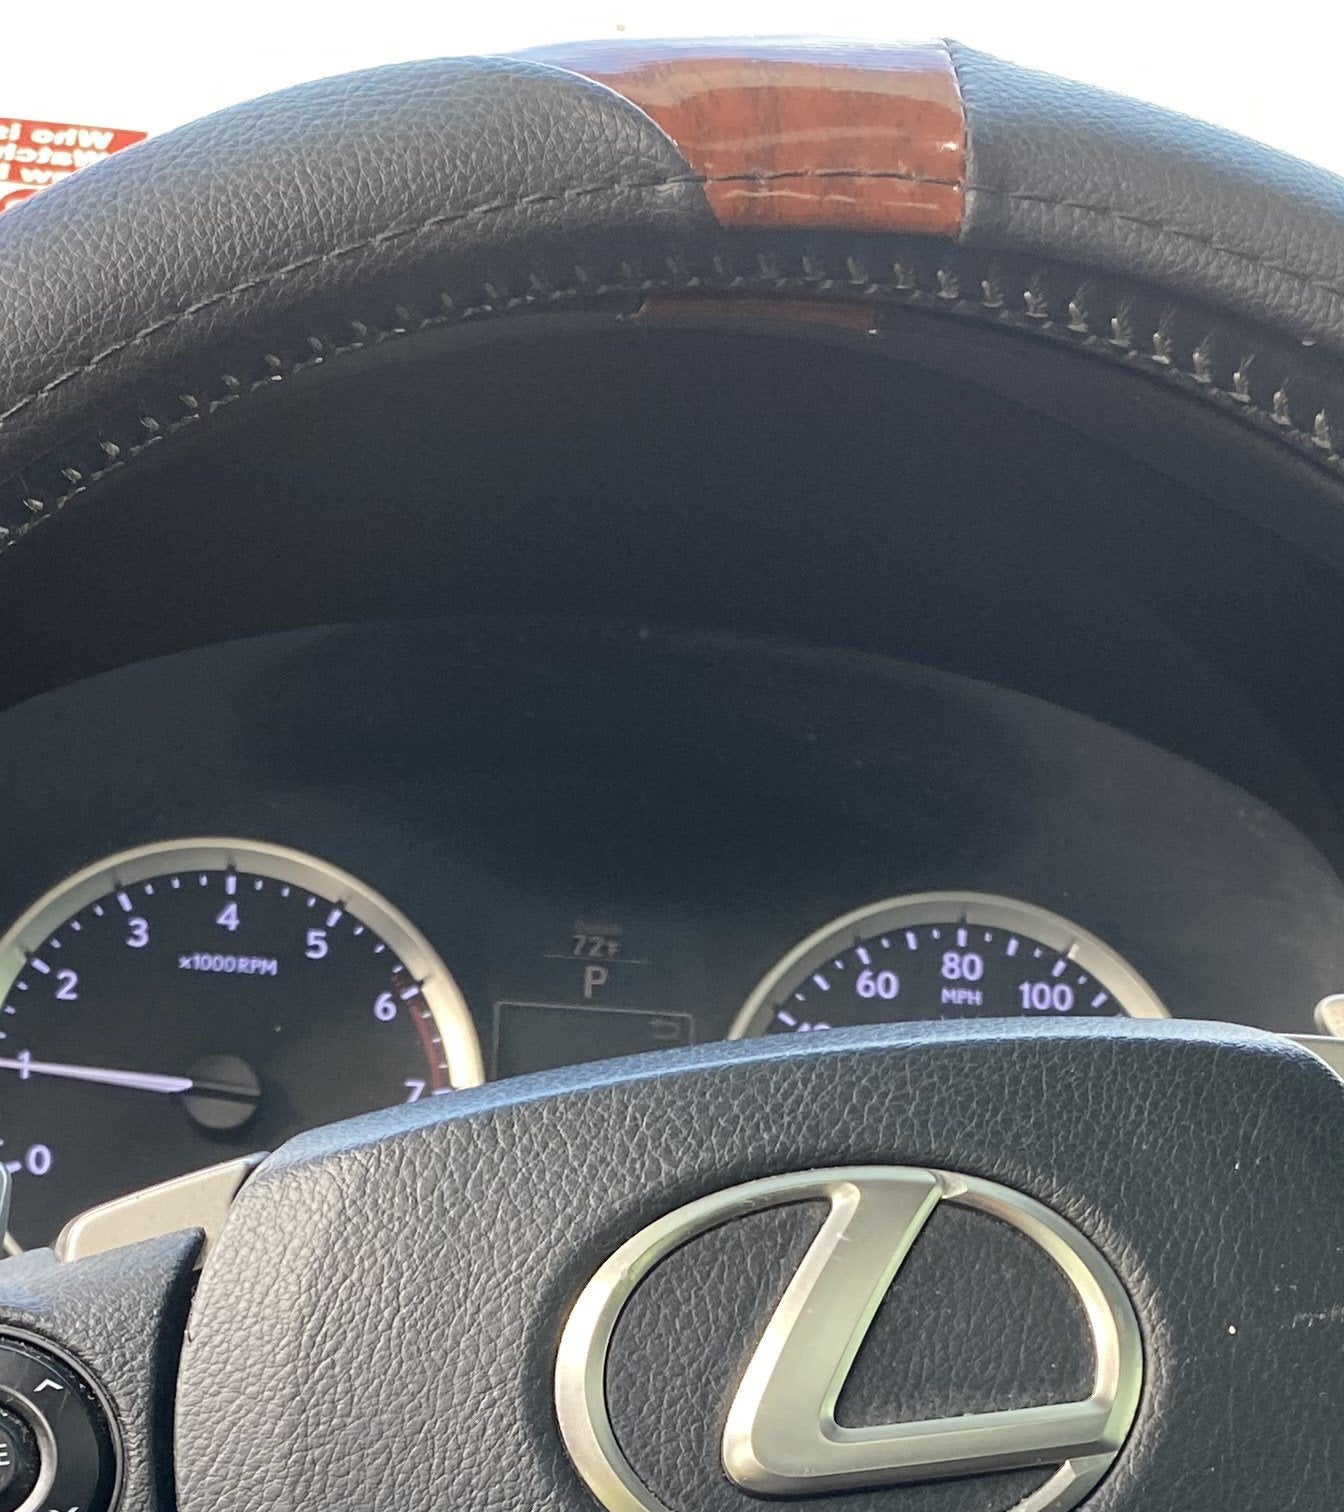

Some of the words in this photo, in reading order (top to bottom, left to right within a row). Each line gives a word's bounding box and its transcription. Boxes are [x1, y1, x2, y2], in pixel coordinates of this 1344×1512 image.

[216, 902, 240, 931] 4
[126, 917, 150, 949] 3
[305, 929, 328, 960] 5
[941, 951, 984, 982] 80
[55, 969, 79, 1001] 2
[584, 965, 609, 999] P
[856, 971, 899, 1000] 60
[1019, 982, 1074, 1012] 100
[373, 992, 397, 1022] 6
[941, 988, 983, 1007] MPH
[404, 1079, 427, 1102] 7
[25, 1144, 51, 1176] 0
